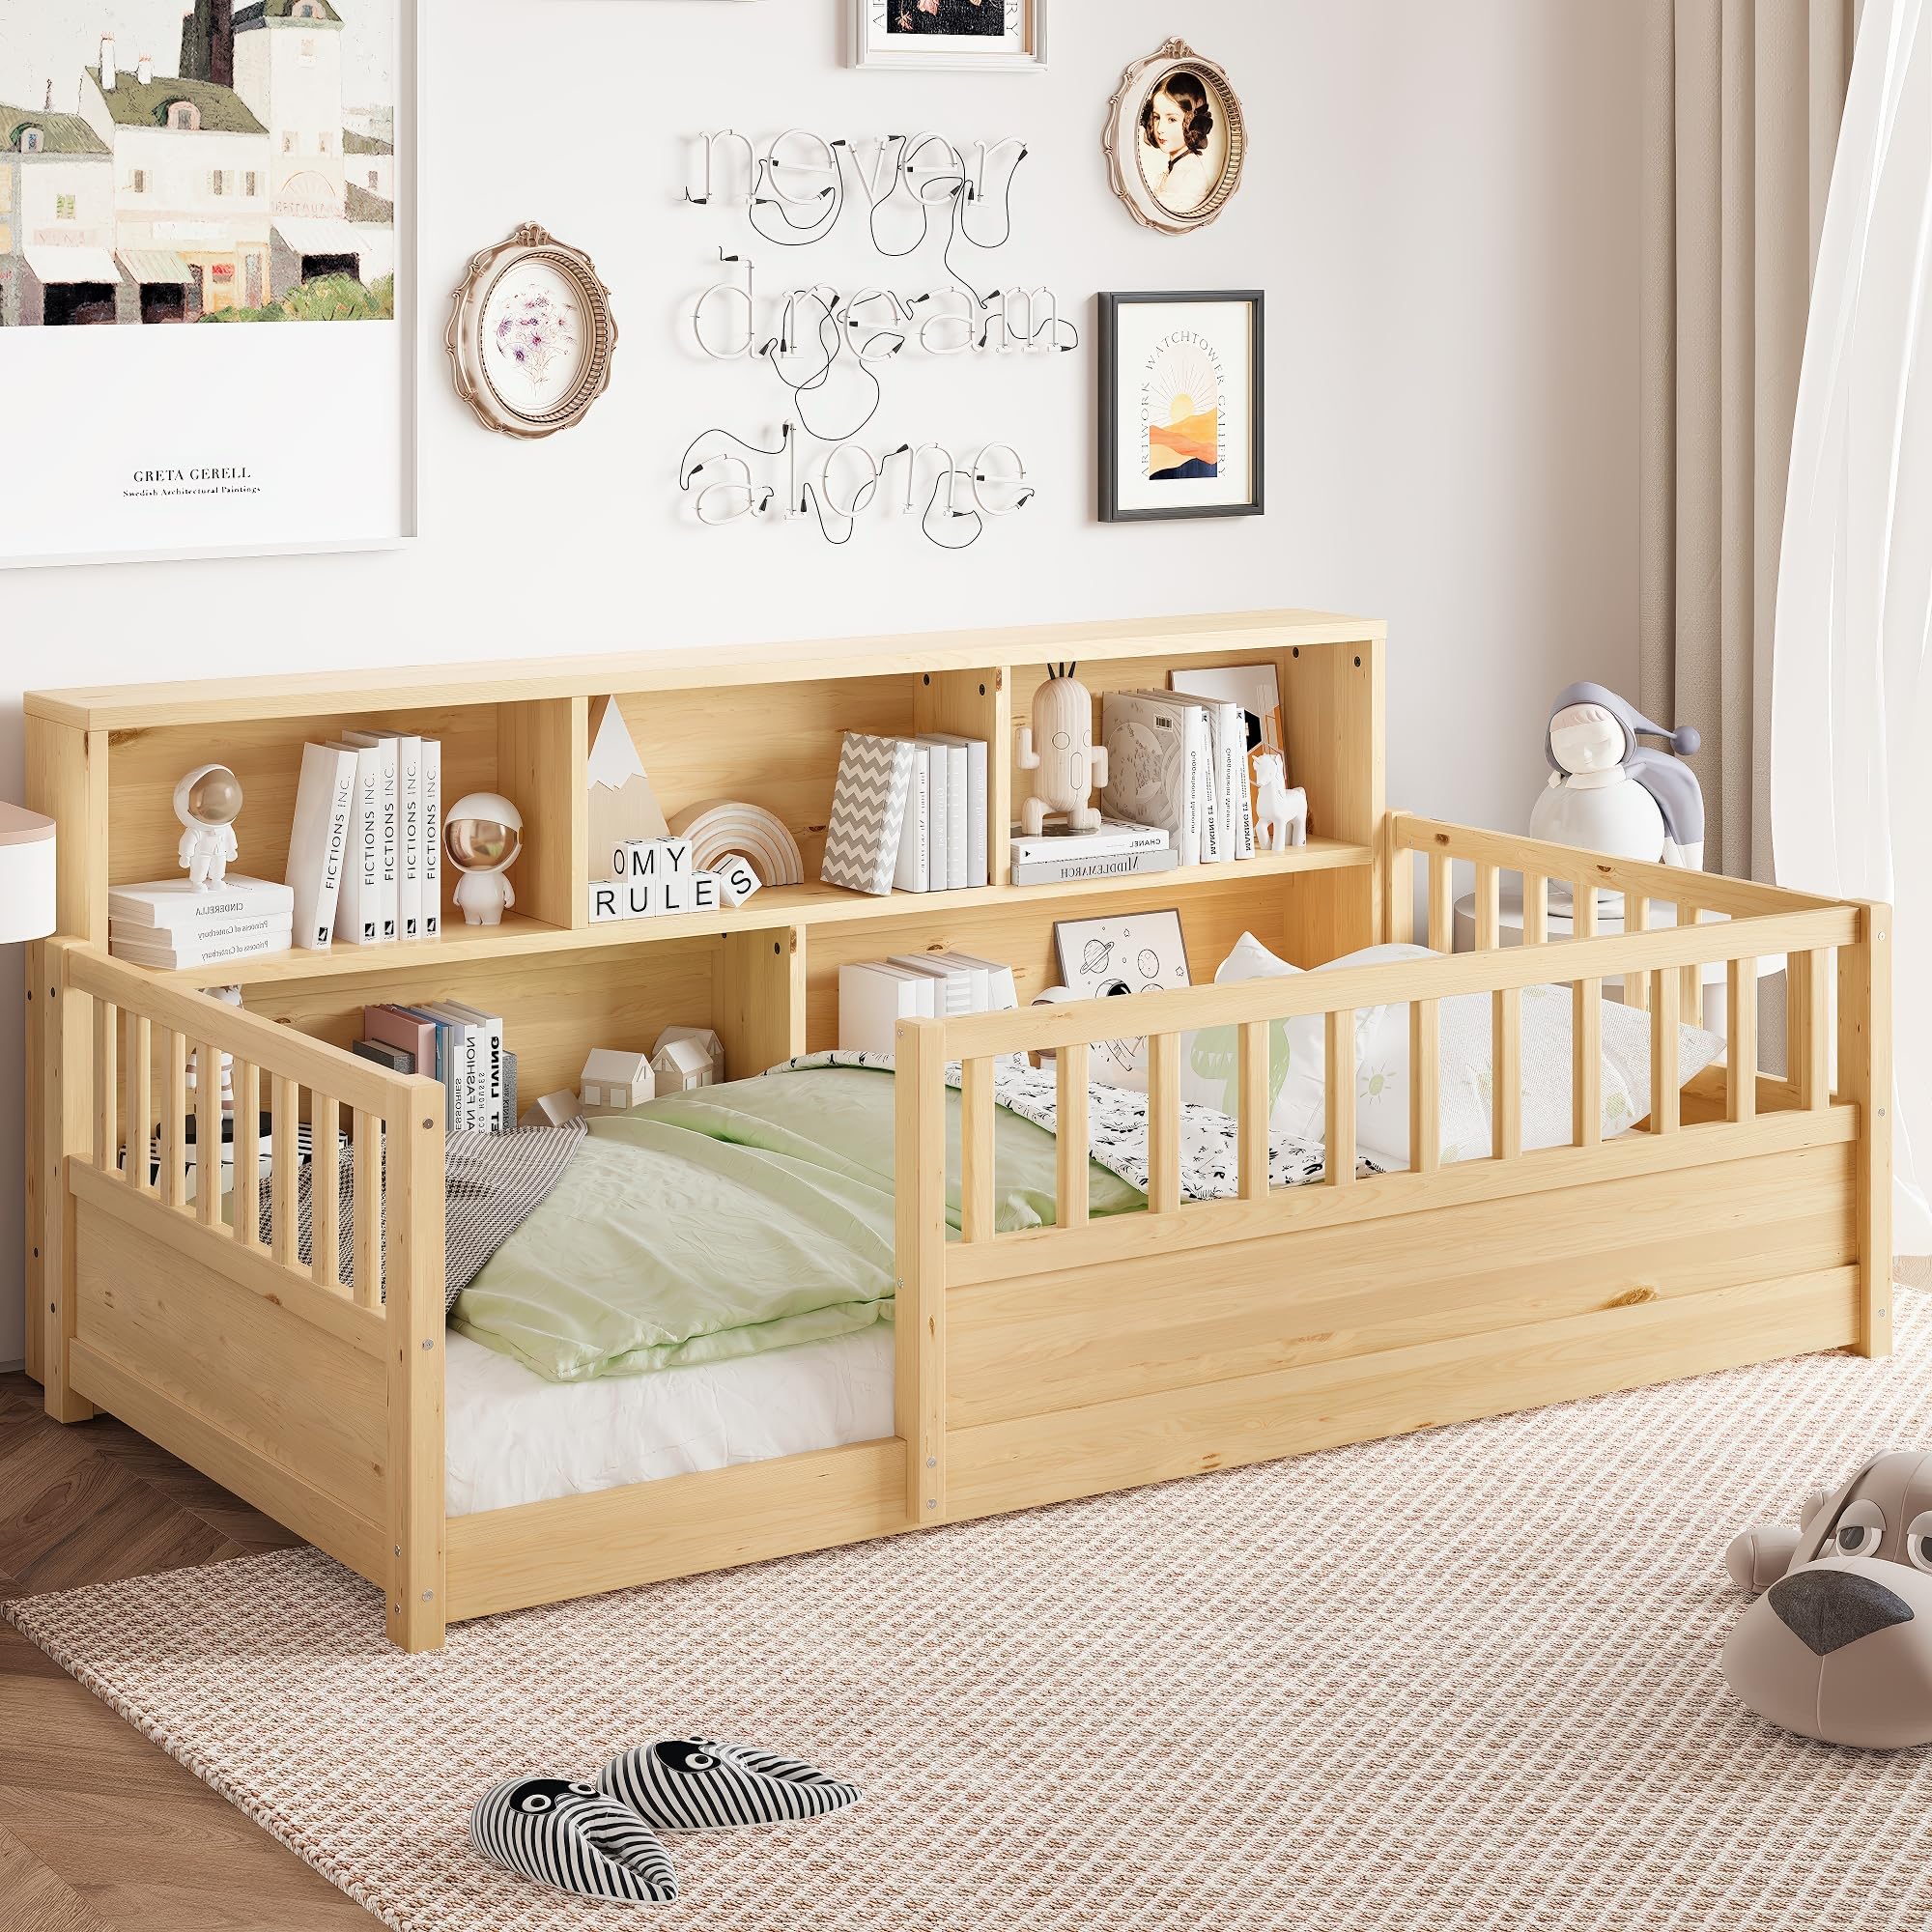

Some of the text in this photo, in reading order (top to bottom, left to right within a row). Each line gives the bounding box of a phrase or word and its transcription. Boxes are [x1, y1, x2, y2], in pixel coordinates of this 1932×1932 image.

[692, 128, 1029, 207] never
[693, 253, 1067, 362] dream
[1140, 330, 1227, 478] ARTWORK WATCHTOWER GALLERY
[123, 485, 261, 497] Swedish Architectural Paintings
[133, 467, 251, 483] GRETA GERELL
[692, 418, 1035, 526] alone
[326, 775, 351, 890] FICTIONS INC.
[364, 773, 375, 886] FICTIONS INC.
[384, 762, 395, 881] FICTIONS INC.
[407, 761, 416, 880] FICTIONS INC.
[426, 765, 437, 880] FICTIONS INC.
[633, 846, 686, 876] MY
[596, 869, 753, 917] RULES
